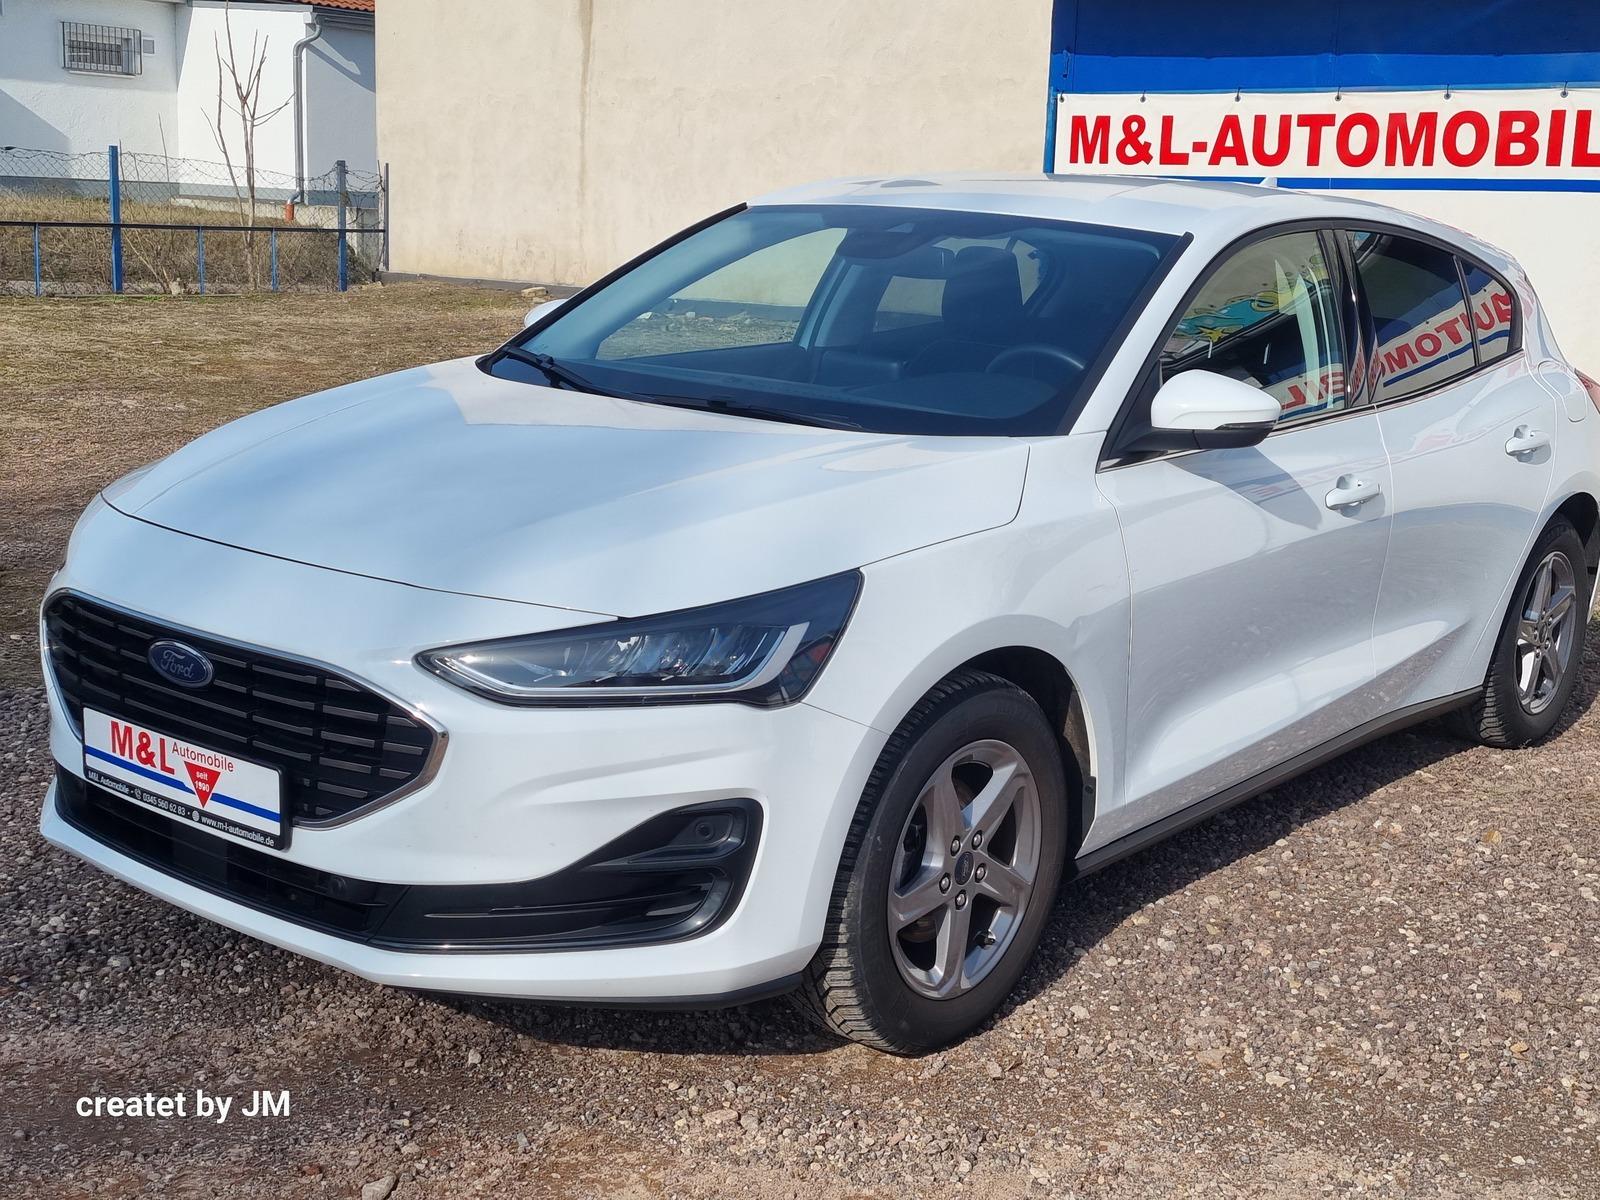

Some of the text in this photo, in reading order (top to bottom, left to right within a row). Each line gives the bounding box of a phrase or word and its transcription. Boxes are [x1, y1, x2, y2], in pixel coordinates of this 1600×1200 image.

[1068, 109, 1600, 167] M&L-AUTOMOBIL
[160, 649, 195, 679] Ford
[110, 720, 234, 775] M&L Automobile
[194, 780, 210, 792] 1990
[195, 770, 209, 781] seit
[100, 776, 129, 795] Automobile
[142, 793, 157, 806] 0345
[157, 799, 169, 810] 560
[169, 803, 177, 813] 62
[177, 806, 186, 816] 83
[200, 815, 275, 847] www.m-l-automobile.de
